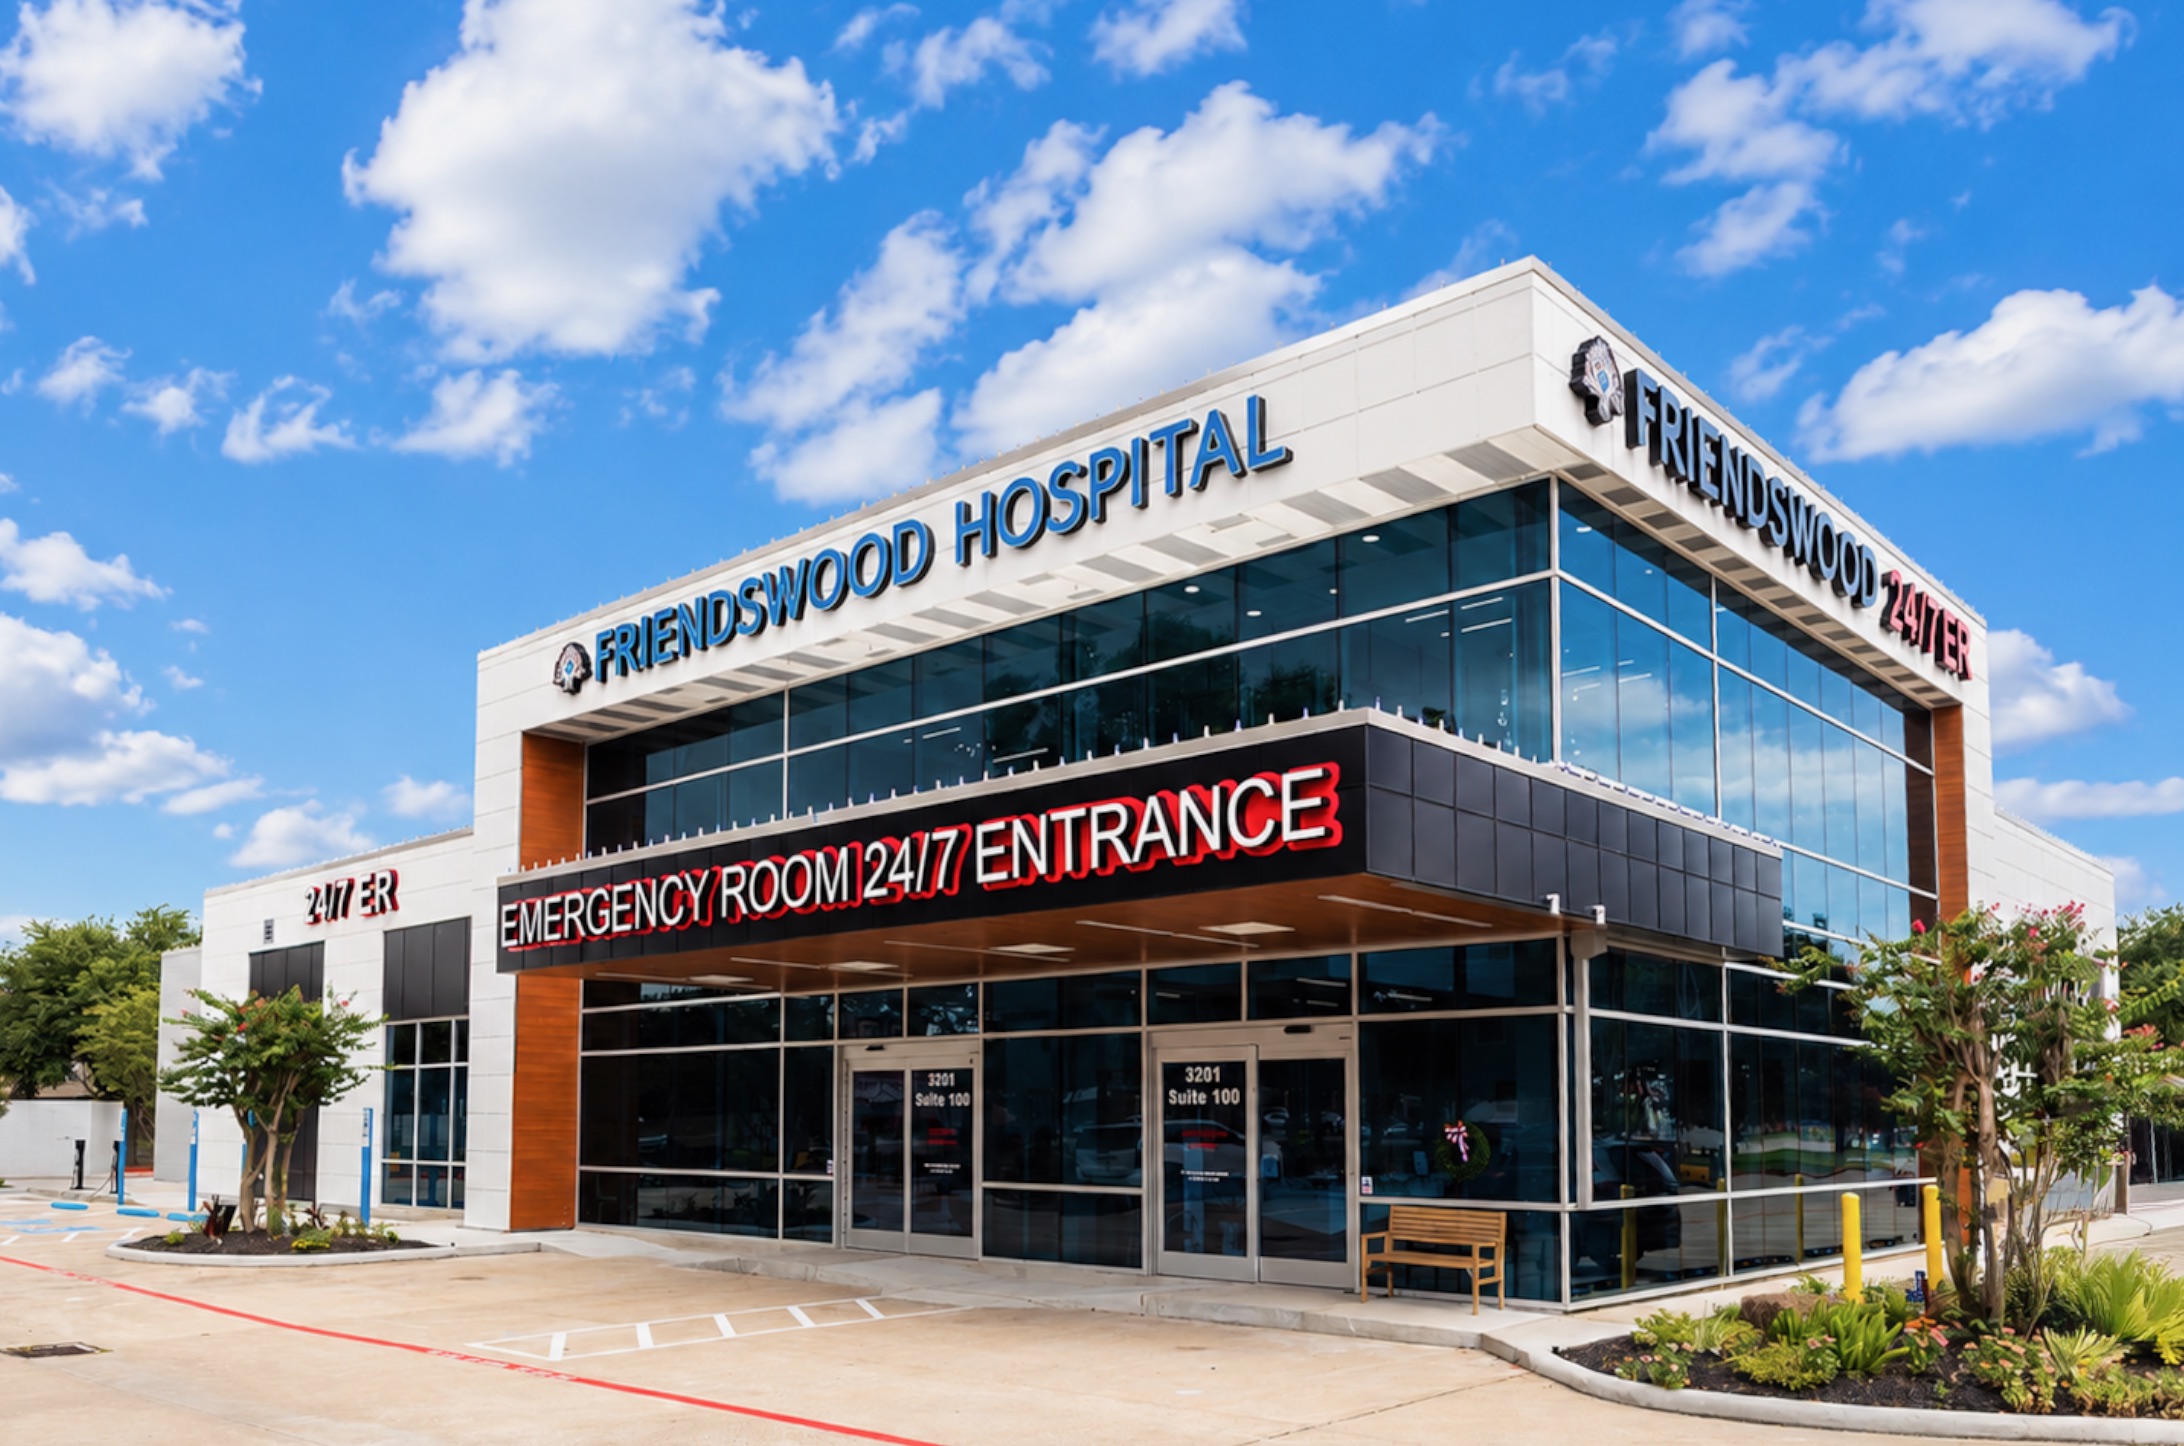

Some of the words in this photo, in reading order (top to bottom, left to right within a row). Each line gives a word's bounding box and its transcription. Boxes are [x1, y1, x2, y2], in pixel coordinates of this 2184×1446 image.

[1624, 367, 1879, 609] FRIENDSWOOD
[595, 518, 935, 683] FRIENDSWOOD
[954, 394, 1293, 567] HOSPITAL
[501, 865, 722, 952] EMERGENCY
[721, 841, 864, 924] ROOM
[863, 823, 973, 904] 24/7
[976, 762, 1342, 891] ENTRANCE
[304, 877, 356, 926] 24/7
[357, 868, 399, 917] ER
[927, 1072, 956, 1087] 3201
[1184, 1066, 1221, 1083] 3201
[915, 1091, 945, 1107] Suite
[948, 1091, 971, 1107] 100
[1168, 1088, 1207, 1105] Suite
[1212, 1088, 1241, 1105] 100
